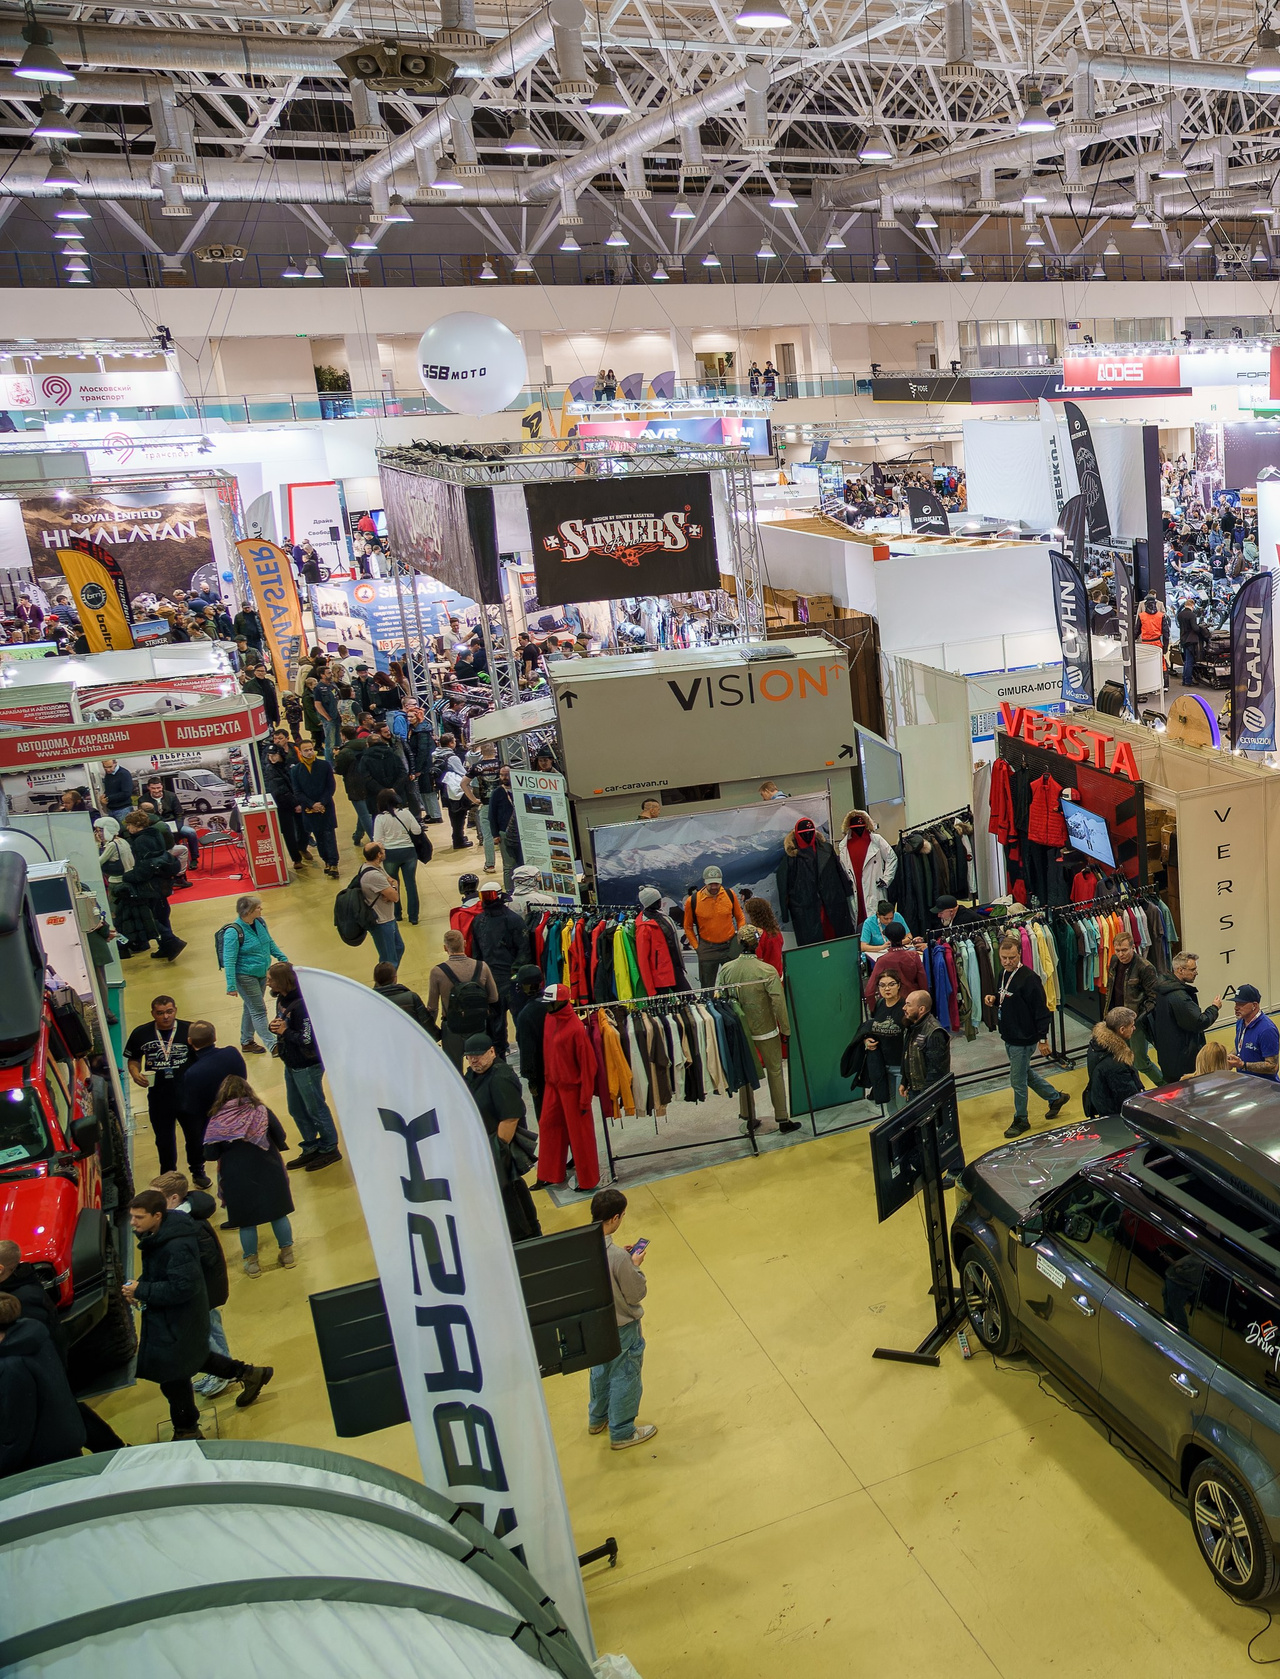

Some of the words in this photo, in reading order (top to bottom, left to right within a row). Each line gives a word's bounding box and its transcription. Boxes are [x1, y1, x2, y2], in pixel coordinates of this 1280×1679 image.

[422, 364, 450, 379] GSB
[451, 367, 486, 381] MOTO
[1098, 363, 1144, 381] AODES
[79, 385, 132, 393] Московский
[80, 394, 125, 402] транспорт
[72, 511, 113, 524] ROYAL
[114, 510, 162, 522] ENFIELD
[914, 516, 942, 524] BERKUT
[42, 521, 198, 548] HIMALAYAN
[561, 511, 687, 559] SINNERS
[145, 638, 168, 647] STRIKER
[1245, 607, 1264, 698] САНИ
[667, 665, 829, 711] VISION
[997, 680, 1063, 697] GIMURA-MOTO
[177, 720, 241, 739] АЛЬБРЕХТА
[17, 738, 69, 753] АВТОДОМА
[78, 731, 130, 745] КАРАВАНЫ
[999, 701, 1141, 782] VERSTA
[36, 743, 114, 758] www.albrehta.ru
[515, 775, 558, 791] VISION
[604, 778, 669, 793] car-caravan.ru
[1245, 1320, 1275, 1355] Drive
